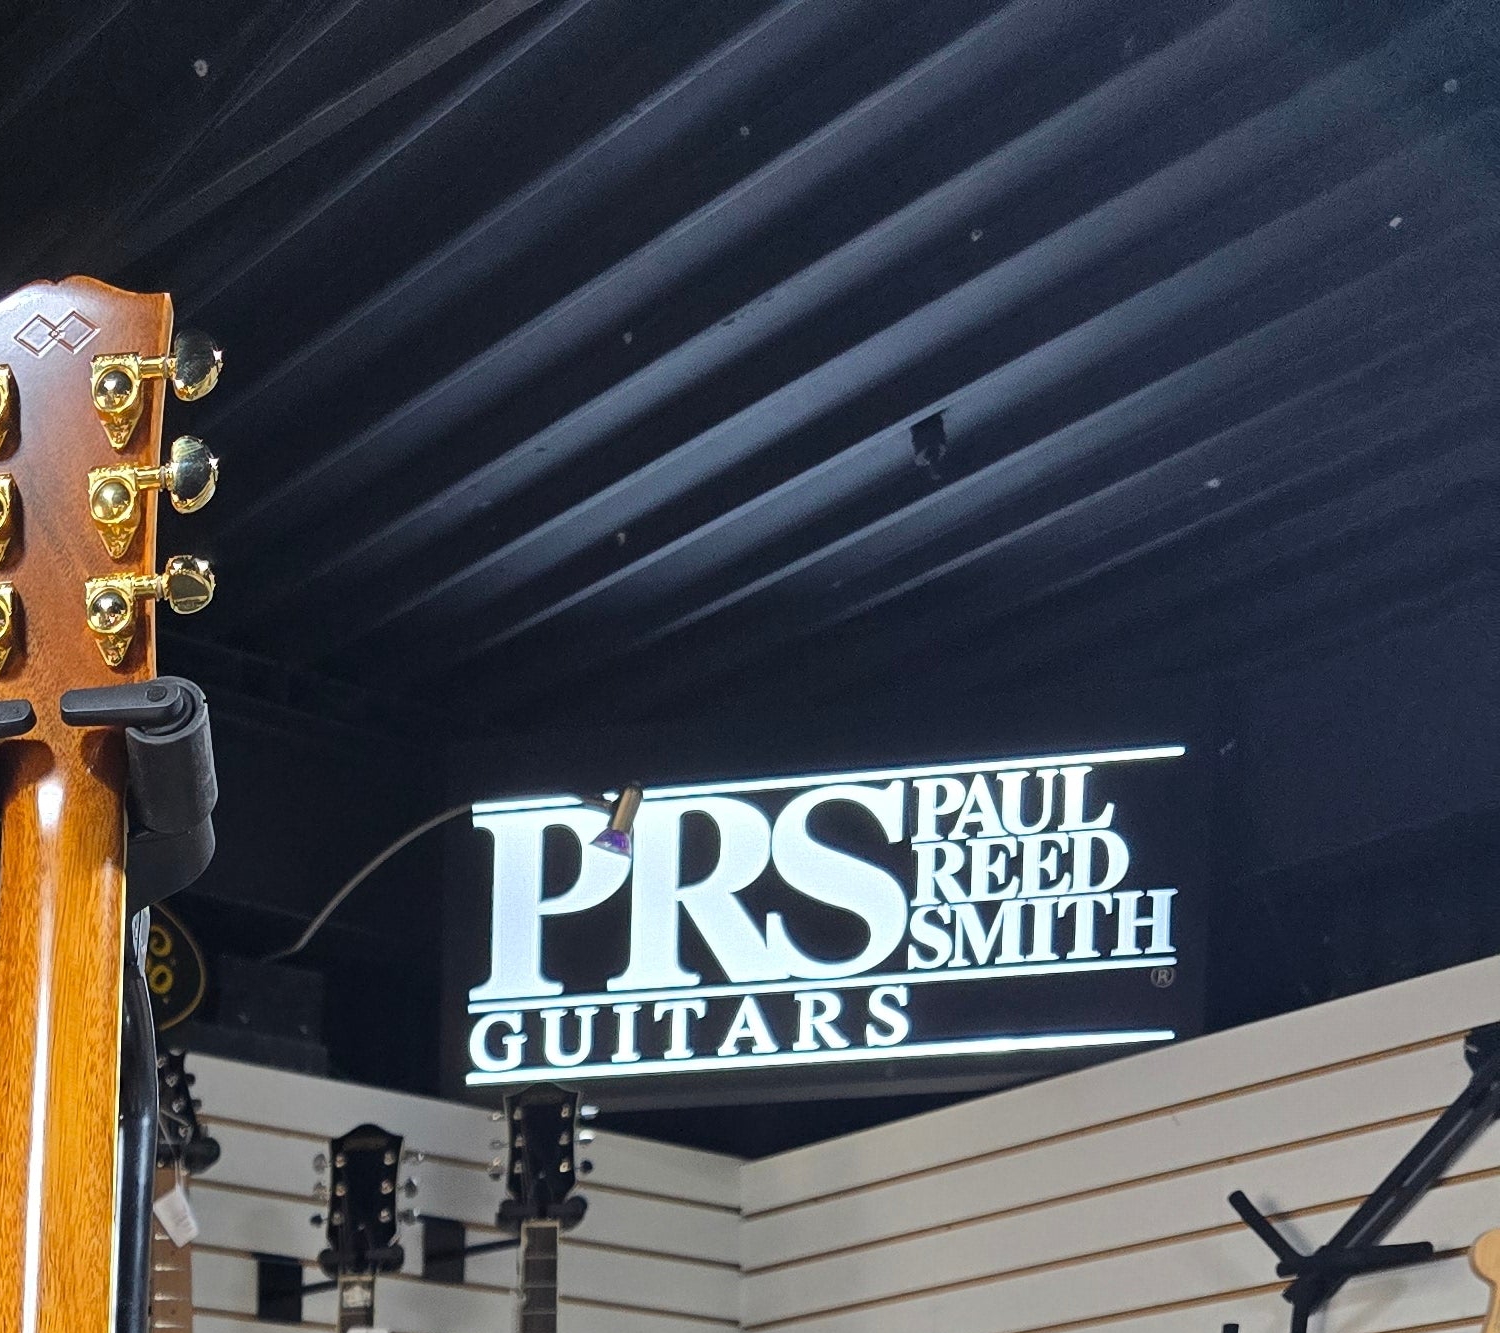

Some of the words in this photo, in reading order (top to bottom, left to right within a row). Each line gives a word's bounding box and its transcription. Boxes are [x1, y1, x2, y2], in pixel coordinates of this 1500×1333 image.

[911, 765, 1114, 844] PAUL
[469, 780, 908, 1000] PRS
[911, 829, 1129, 906] REED
[906, 888, 1178, 971] SMITH
[468, 985, 911, 1072] GUITARS
